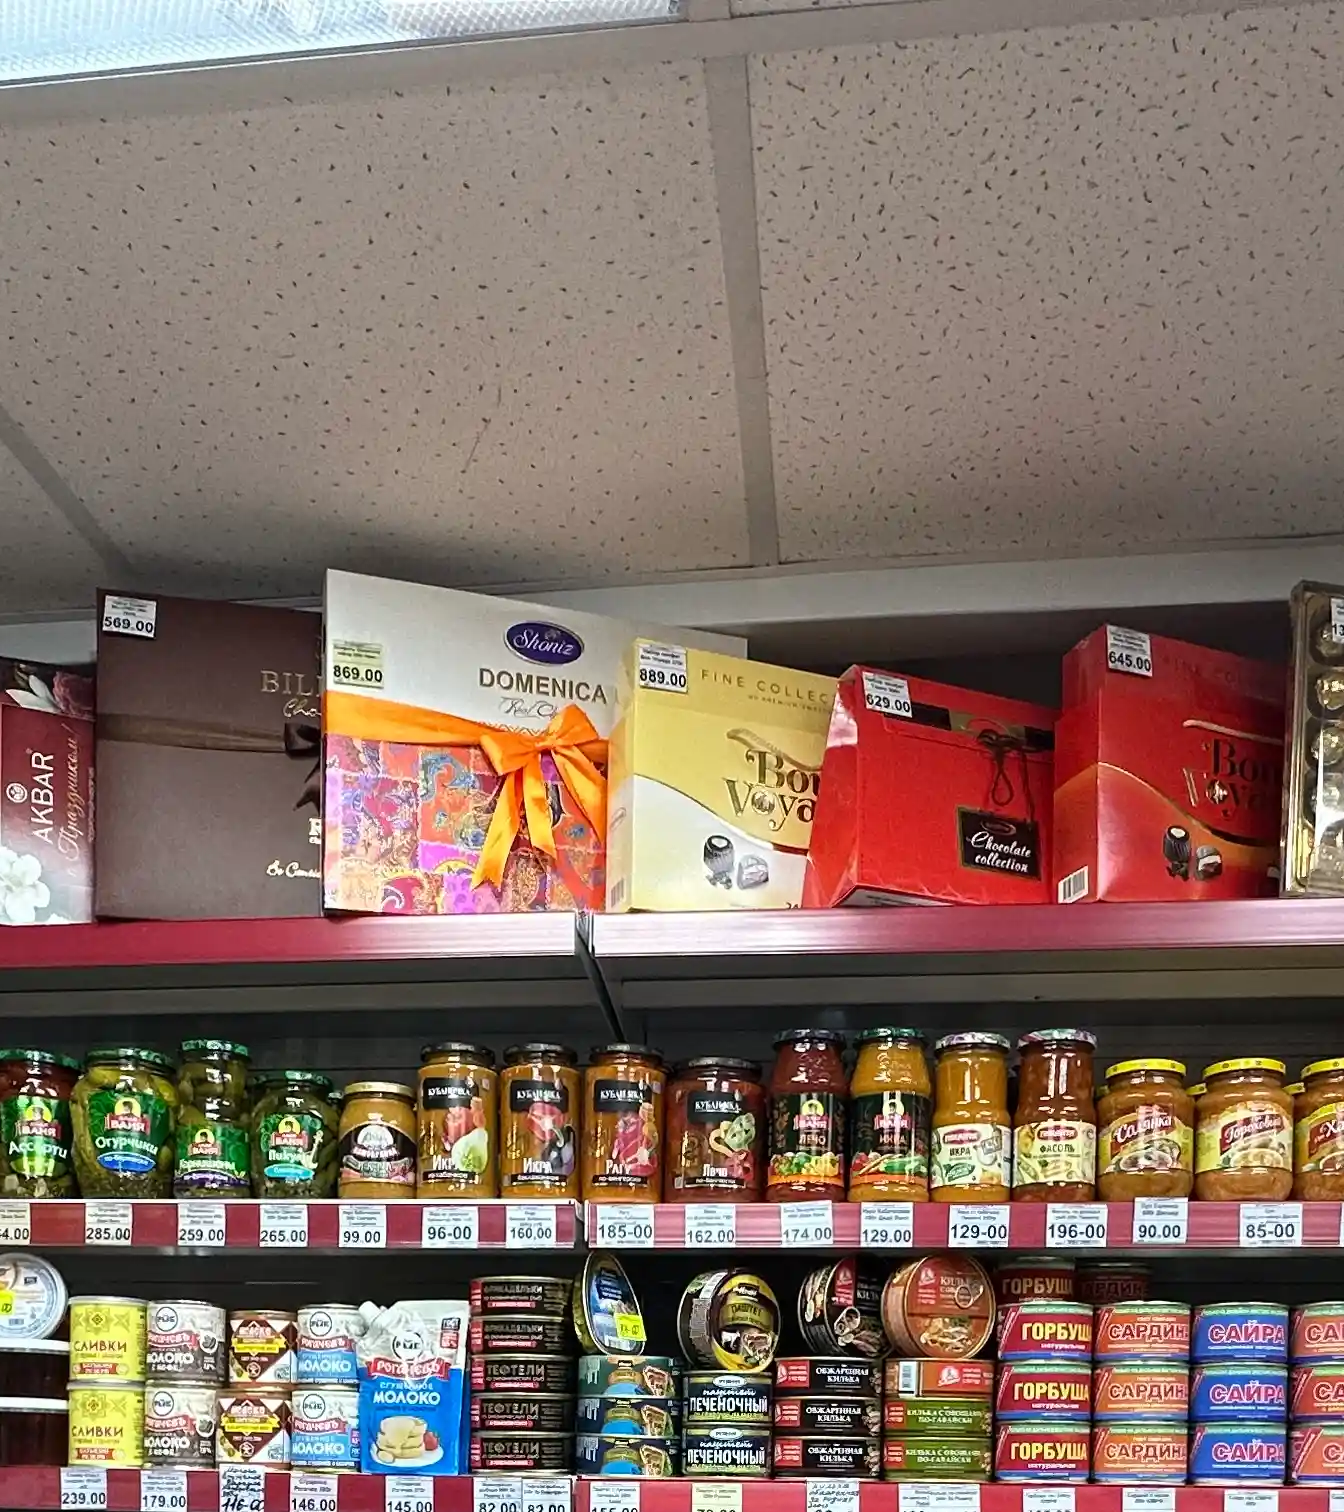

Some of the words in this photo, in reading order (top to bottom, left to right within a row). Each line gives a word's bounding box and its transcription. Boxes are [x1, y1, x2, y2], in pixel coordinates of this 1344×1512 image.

[513, 625, 575, 657] Shoniz
[1108, 651, 1151, 671] 645.00
[333, 665, 383, 683] 869.00
[639, 669, 686, 689] 889.00
[701, 669, 745, 688] FINE
[479, 668, 607, 704] DOMENICA
[866, 693, 911, 714] 629.00
[29, 751, 54, 844] AKBAR
[969, 832, 1032, 859] Chocolate
[975, 853, 1028, 873] collection
[605, 1158, 632, 1175] РАГУ
[87, 1226, 131, 1241] 285.00
[427, 1224, 473, 1240] 96-00
[598, 1224, 653, 1239] 185-00
[950, 1223, 1008, 1240] 129-00
[1138, 1224, 1181, 1239] 90.00
[1245, 1222, 1295, 1240] 85-00
[1208, 1320, 1285, 1344] САЙРА
[74, 1340, 127, 1354] СЛИВКИ
[486, 1364, 545, 1378] ТЕФТЕЛИ
[373, 1390, 441, 1406] МОЛОКО
